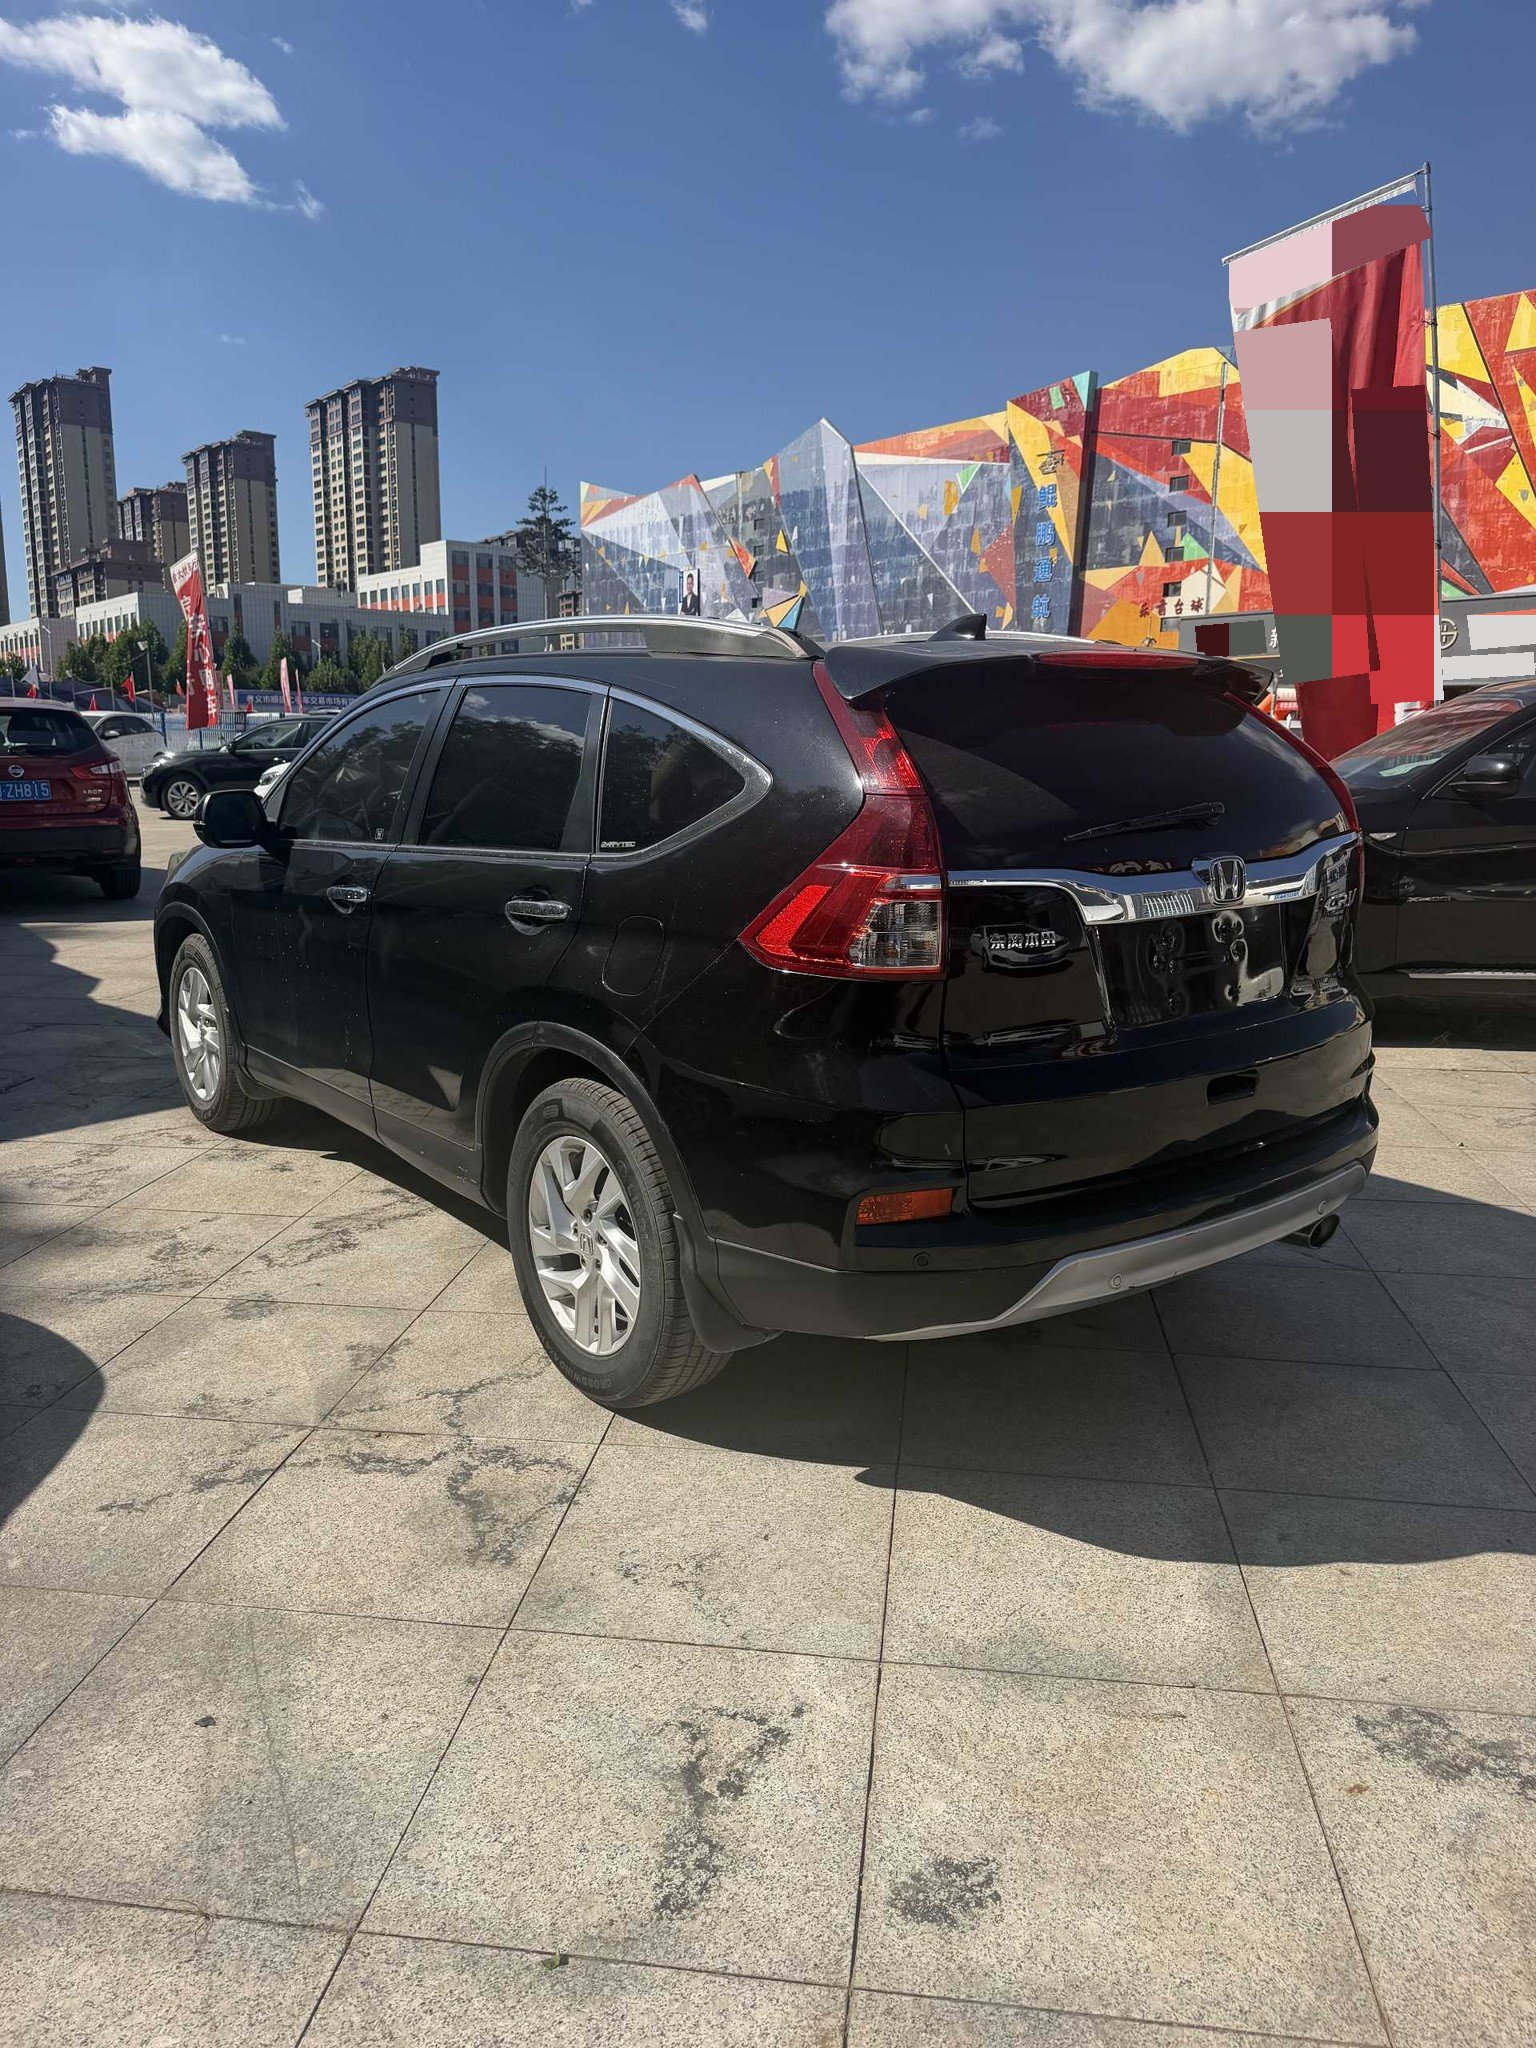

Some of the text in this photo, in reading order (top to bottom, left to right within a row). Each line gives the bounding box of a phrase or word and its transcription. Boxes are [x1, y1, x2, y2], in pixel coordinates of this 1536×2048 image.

[1031, 484, 1058, 618] 鲲鹏通航
[0, 782, 50, 799] ·ZH815
[989, 931, 1056, 949] 东风本田
